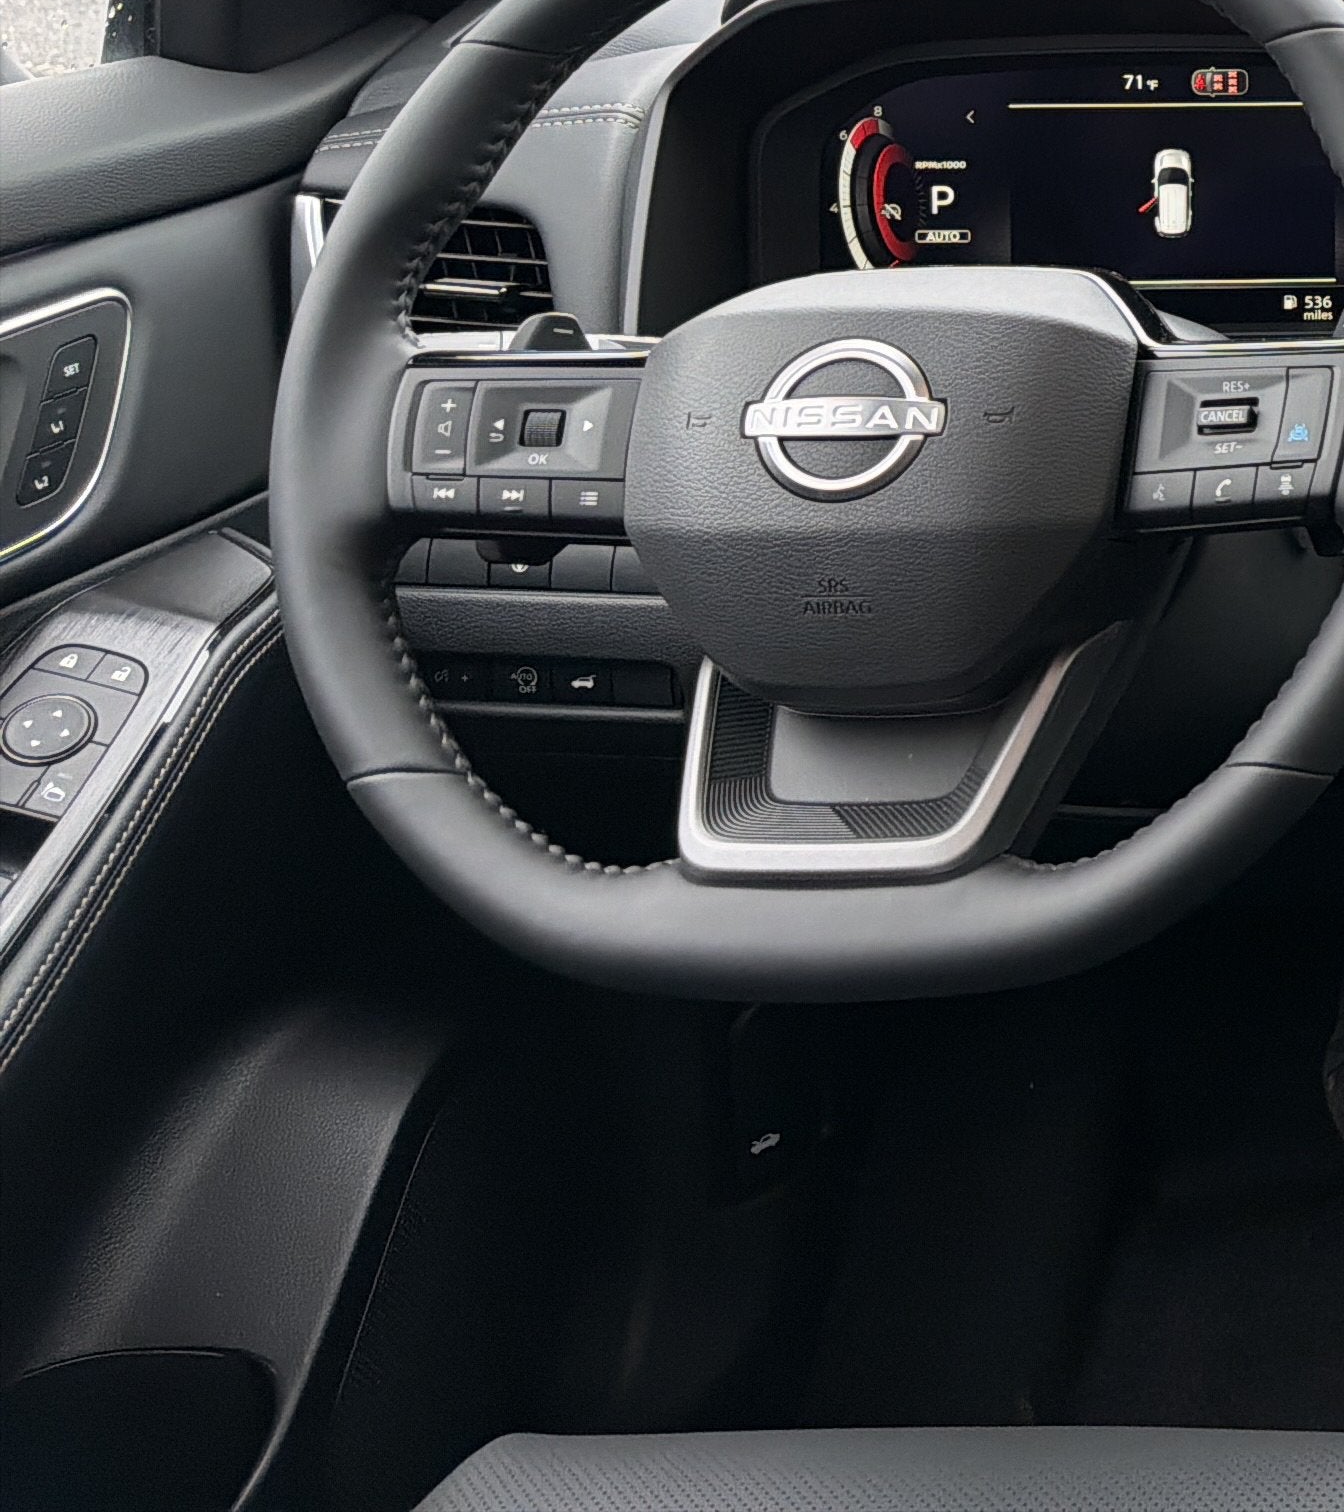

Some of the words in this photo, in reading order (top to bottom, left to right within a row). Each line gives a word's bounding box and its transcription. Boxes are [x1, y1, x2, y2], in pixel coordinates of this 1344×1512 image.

[873, 106, 882, 116] 8
[839, 130, 848, 140] 6
[915, 161, 966, 169] RPMx1000
[931, 185, 955, 215] P
[926, 232, 960, 241] AUTO
[1304, 296, 1332, 309] 536
[1303, 310, 1333, 321] miles
[63, 363, 80, 377] SET
[751, 404, 939, 430] NISSAN
[1200, 410, 1245, 422] CANCEL
[528, 454, 548, 465] OK
[816, 578, 850, 594] SRS
[802, 600, 872, 616] AIRBAG
[519, 685, 537, 694] OFF
